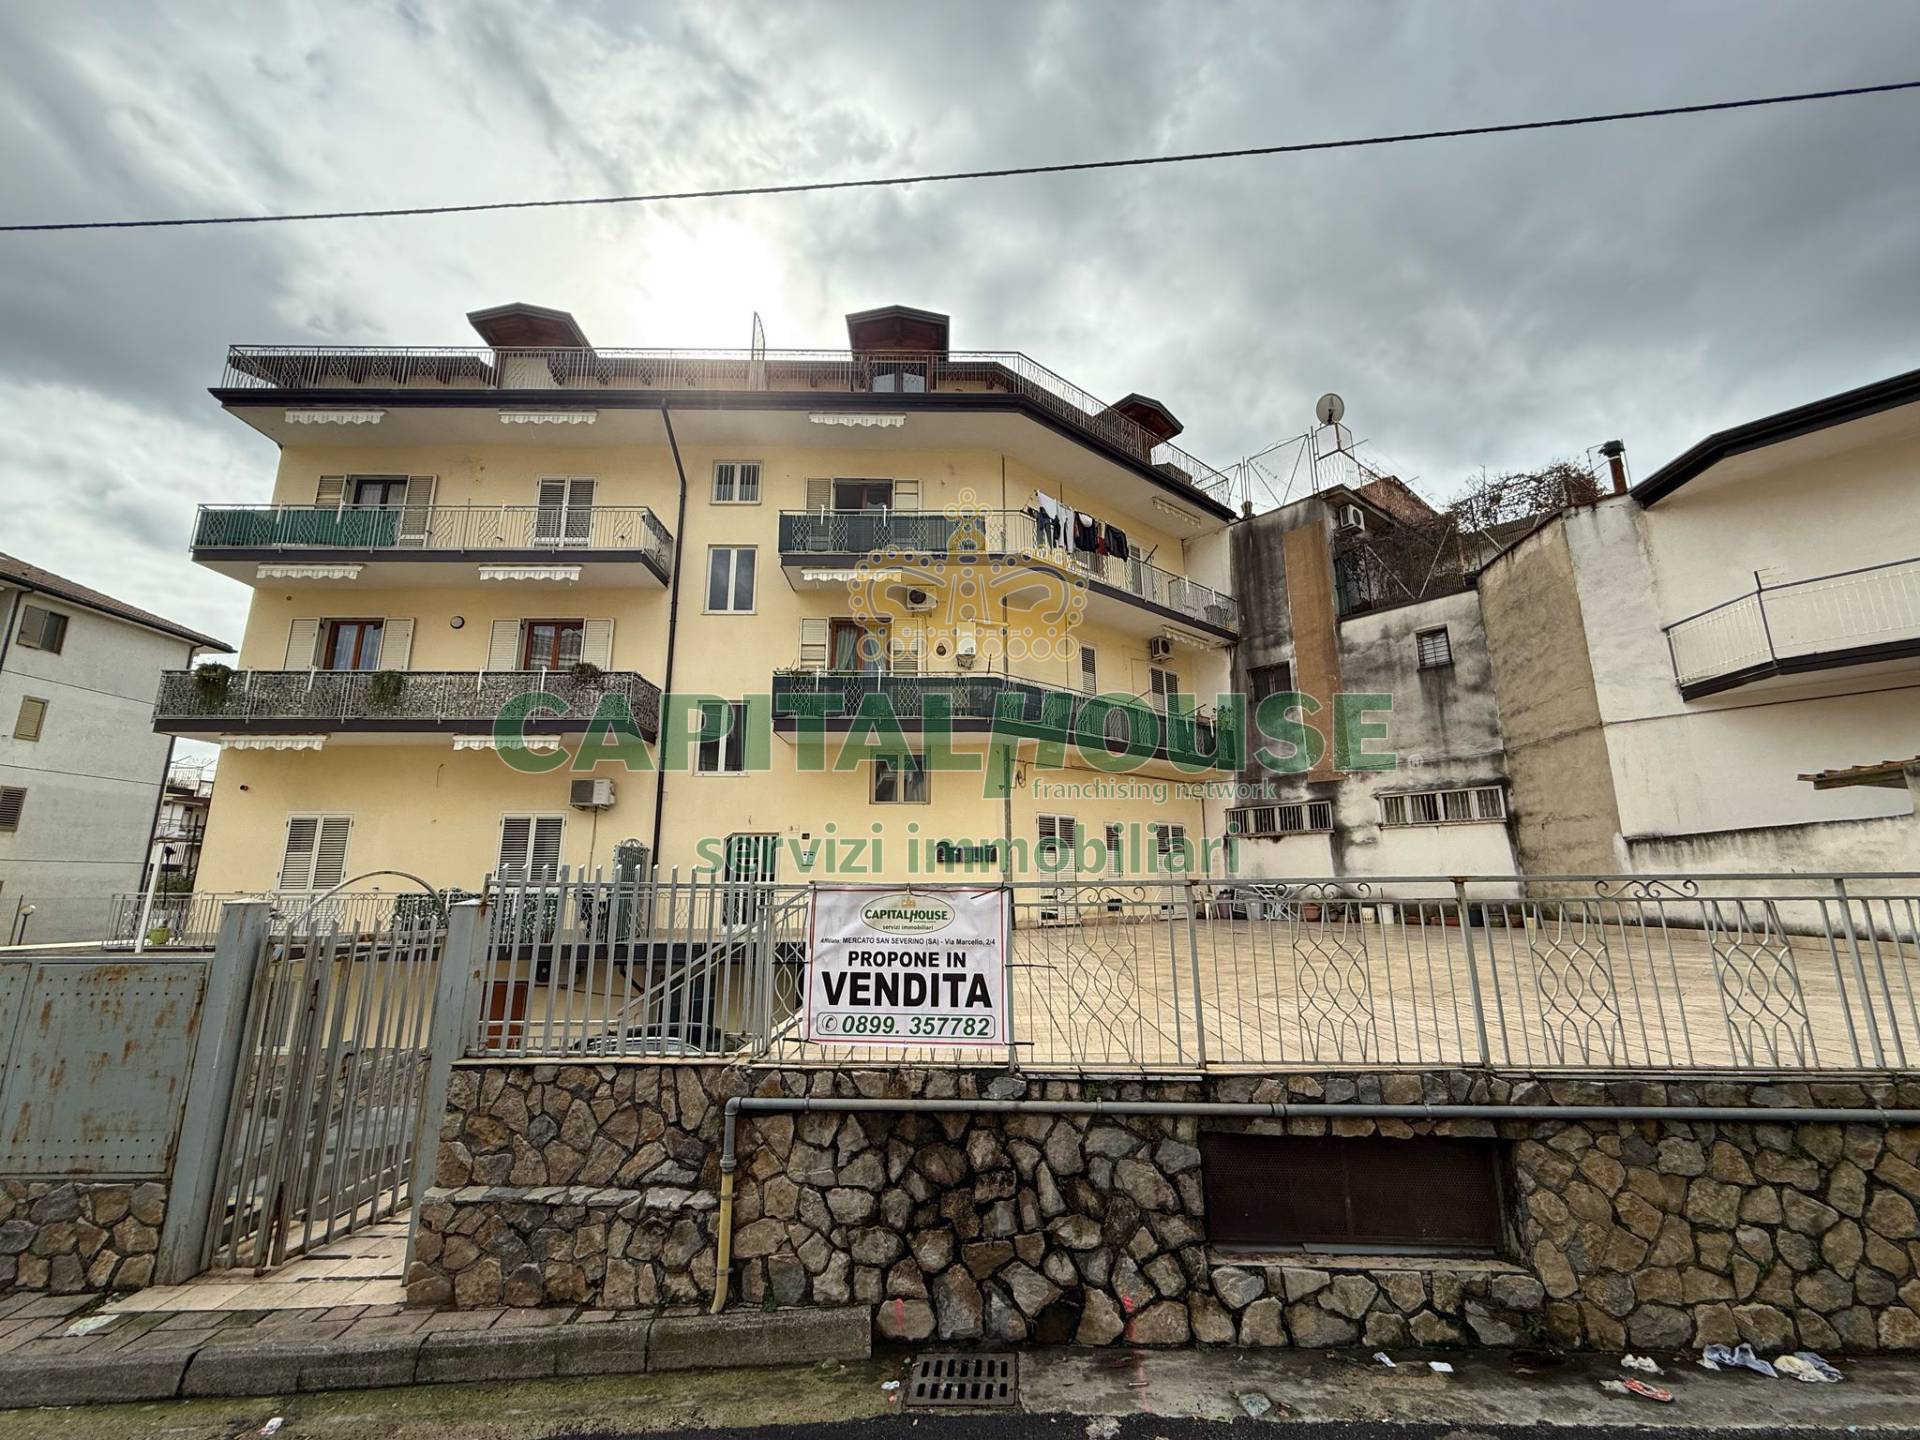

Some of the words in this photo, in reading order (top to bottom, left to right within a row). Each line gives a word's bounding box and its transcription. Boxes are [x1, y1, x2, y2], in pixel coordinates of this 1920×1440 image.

[890, 937, 924, 945] SEVERINO
[925, 937, 940, 946] (SA)
[848, 951, 940, 968] PROPONE
[946, 952, 966, 968] IN
[821, 971, 993, 1008] VENDITA
[842, 1015, 900, 1034] 0899.
[909, 1017, 990, 1036] 357782
